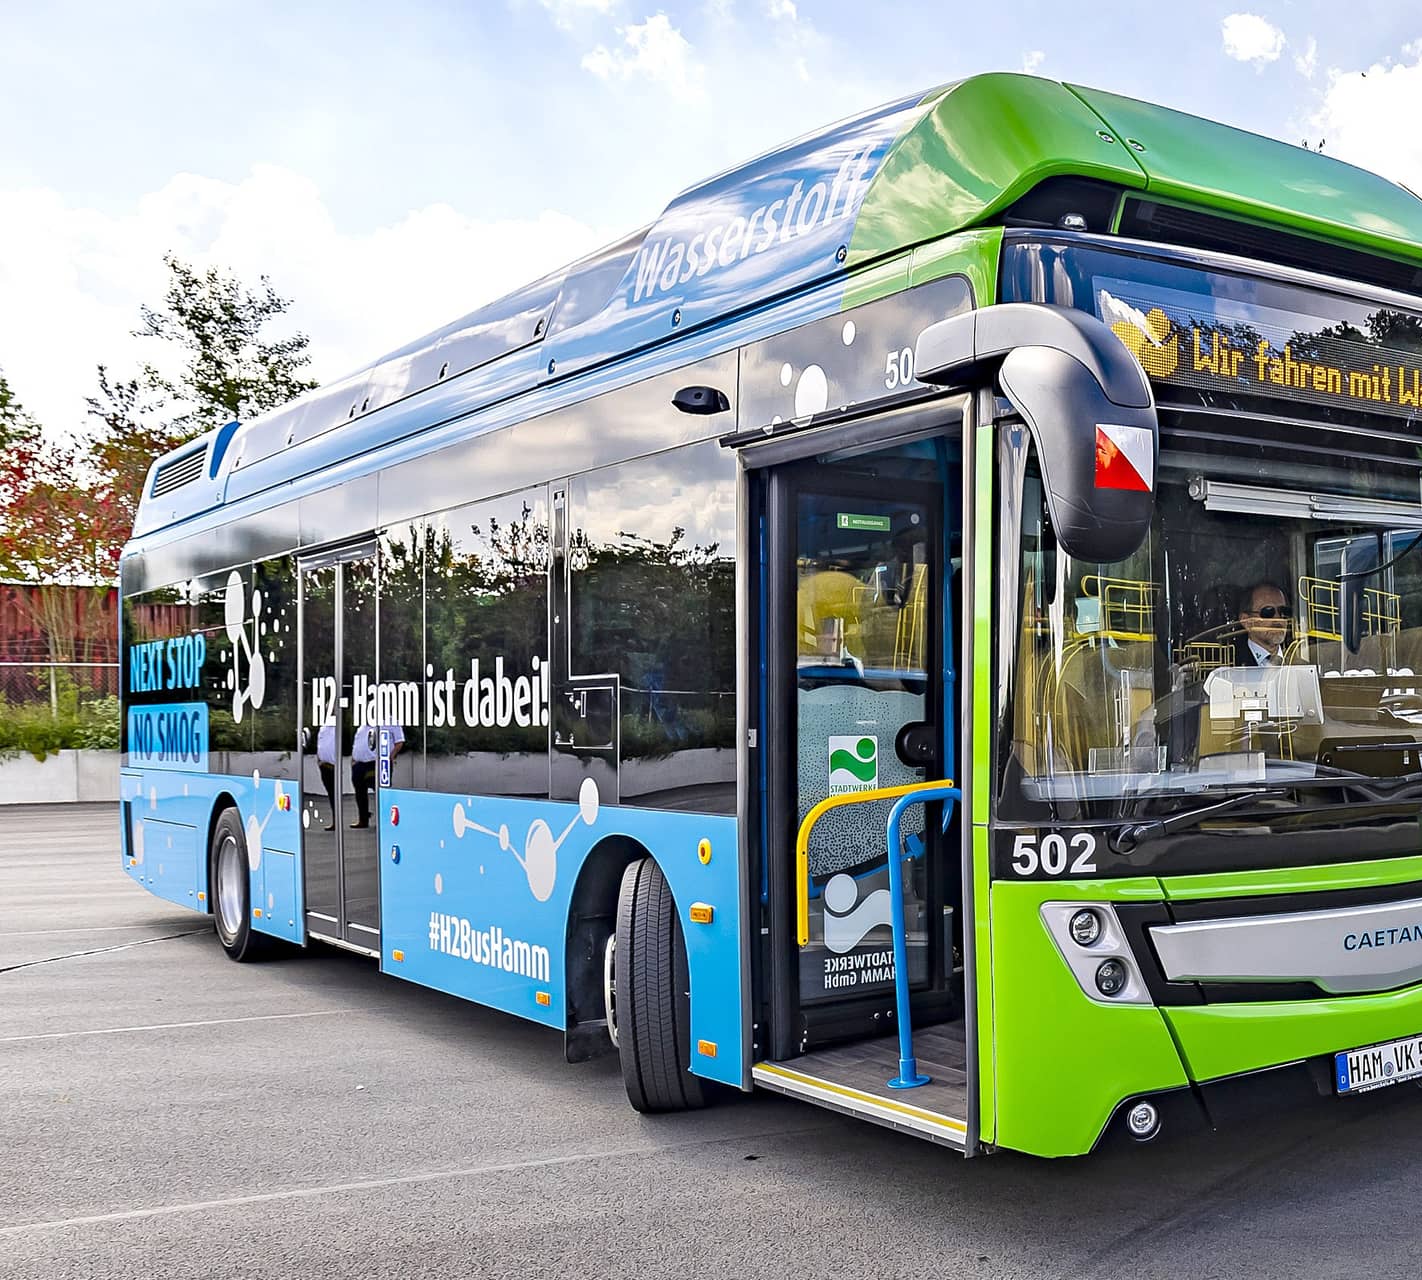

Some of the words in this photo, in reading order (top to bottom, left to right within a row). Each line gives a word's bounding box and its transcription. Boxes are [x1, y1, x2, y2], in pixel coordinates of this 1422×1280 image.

[633, 143, 879, 303] Wasserstoff
[885, 347, 914, 390] 50
[1193, 327, 1244, 377] Wir
[1254, 338, 1342, 394] fahren
[1349, 364, 1391, 402] mit
[130, 640, 164, 693] NEXT
[167, 633, 206, 690] STOP
[426, 663, 456, 727] ist
[463, 655, 549, 728] dabei!
[134, 712, 153, 761] NO
[157, 710, 201, 764] SMOG
[1012, 832, 1097, 876] 502
[428, 911, 551, 983] #H2BusHamm
[1349, 1050, 1384, 1084] HAM
[1393, 1043, 1415, 1073] VK
